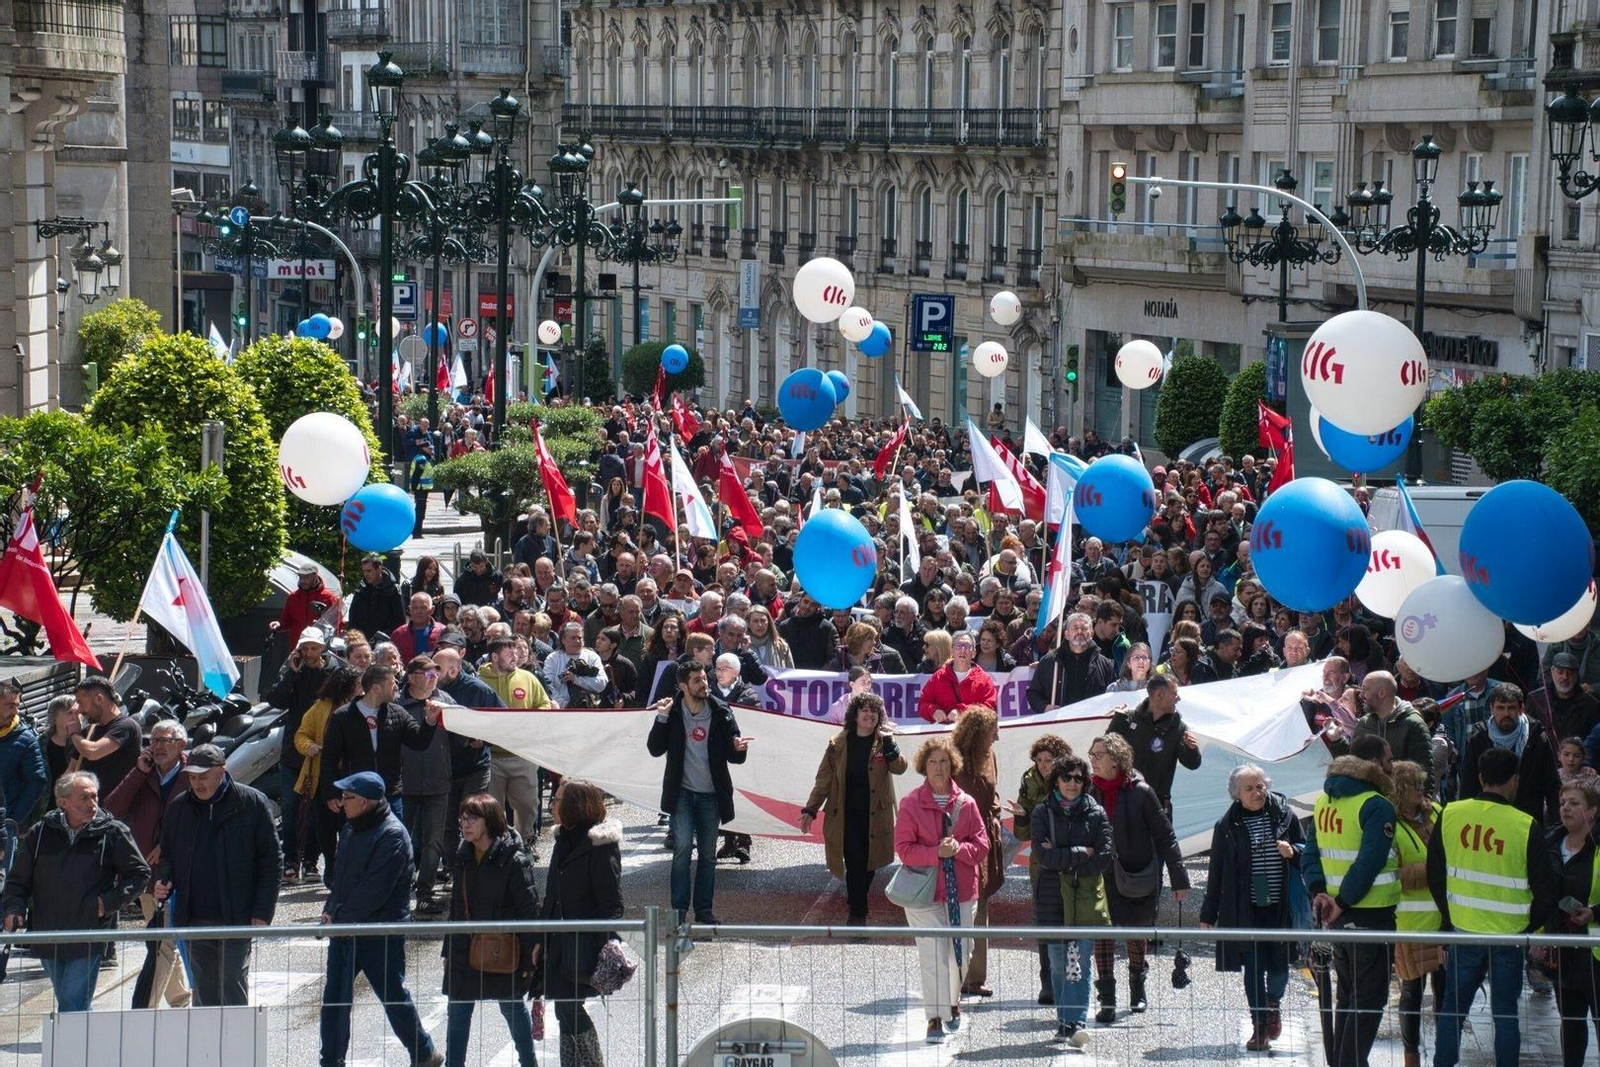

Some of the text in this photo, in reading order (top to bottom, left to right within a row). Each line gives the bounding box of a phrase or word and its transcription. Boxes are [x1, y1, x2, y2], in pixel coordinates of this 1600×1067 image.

[823, 285, 846, 306] CIG
[1143, 297, 1178, 319] NOTARÍA
[921, 301, 946, 332] P
[1303, 340, 1345, 385] CIG
[1400, 360, 1426, 386] CIG
[1318, 806, 1343, 834] CIG
[1460, 823, 1505, 856] CIG
